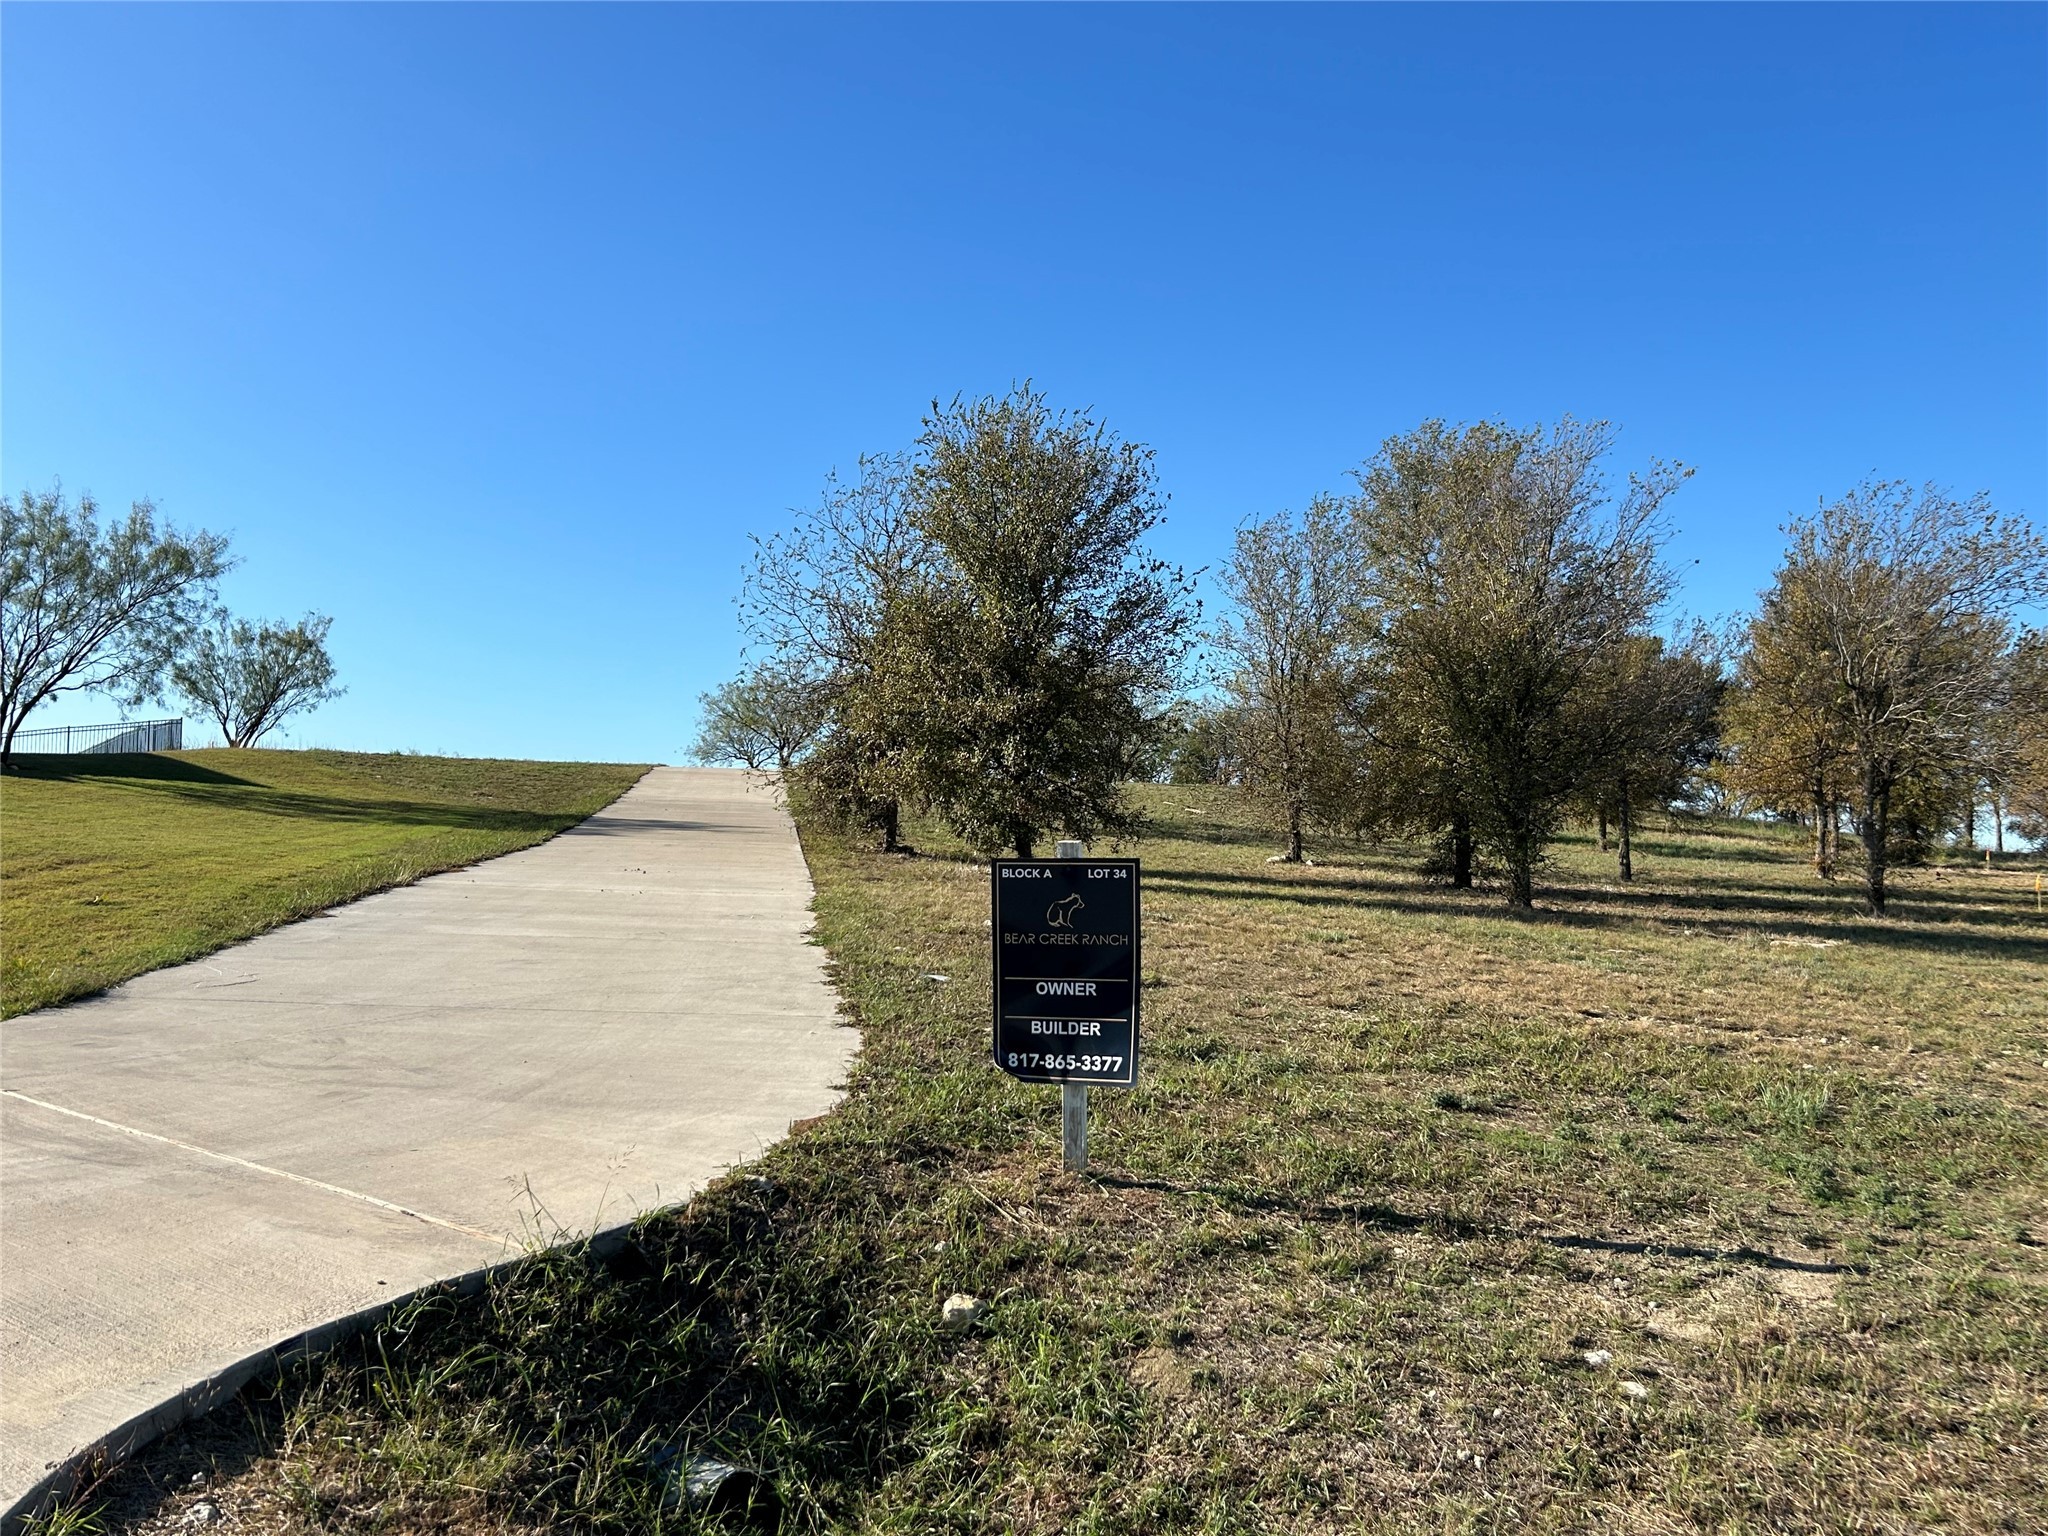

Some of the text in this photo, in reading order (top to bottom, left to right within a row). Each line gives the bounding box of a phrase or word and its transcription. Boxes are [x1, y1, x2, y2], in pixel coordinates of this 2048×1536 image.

[1002, 868, 1052, 878] BLOCK A
[1088, 869, 1127, 879] LOT 34
[1004, 933, 1128, 945] BEAR CREEK RANCH
[1036, 982, 1097, 996] OWNER
[1031, 1020, 1101, 1036] BUILDER
[1008, 1052, 1123, 1072] 817-865-3377
